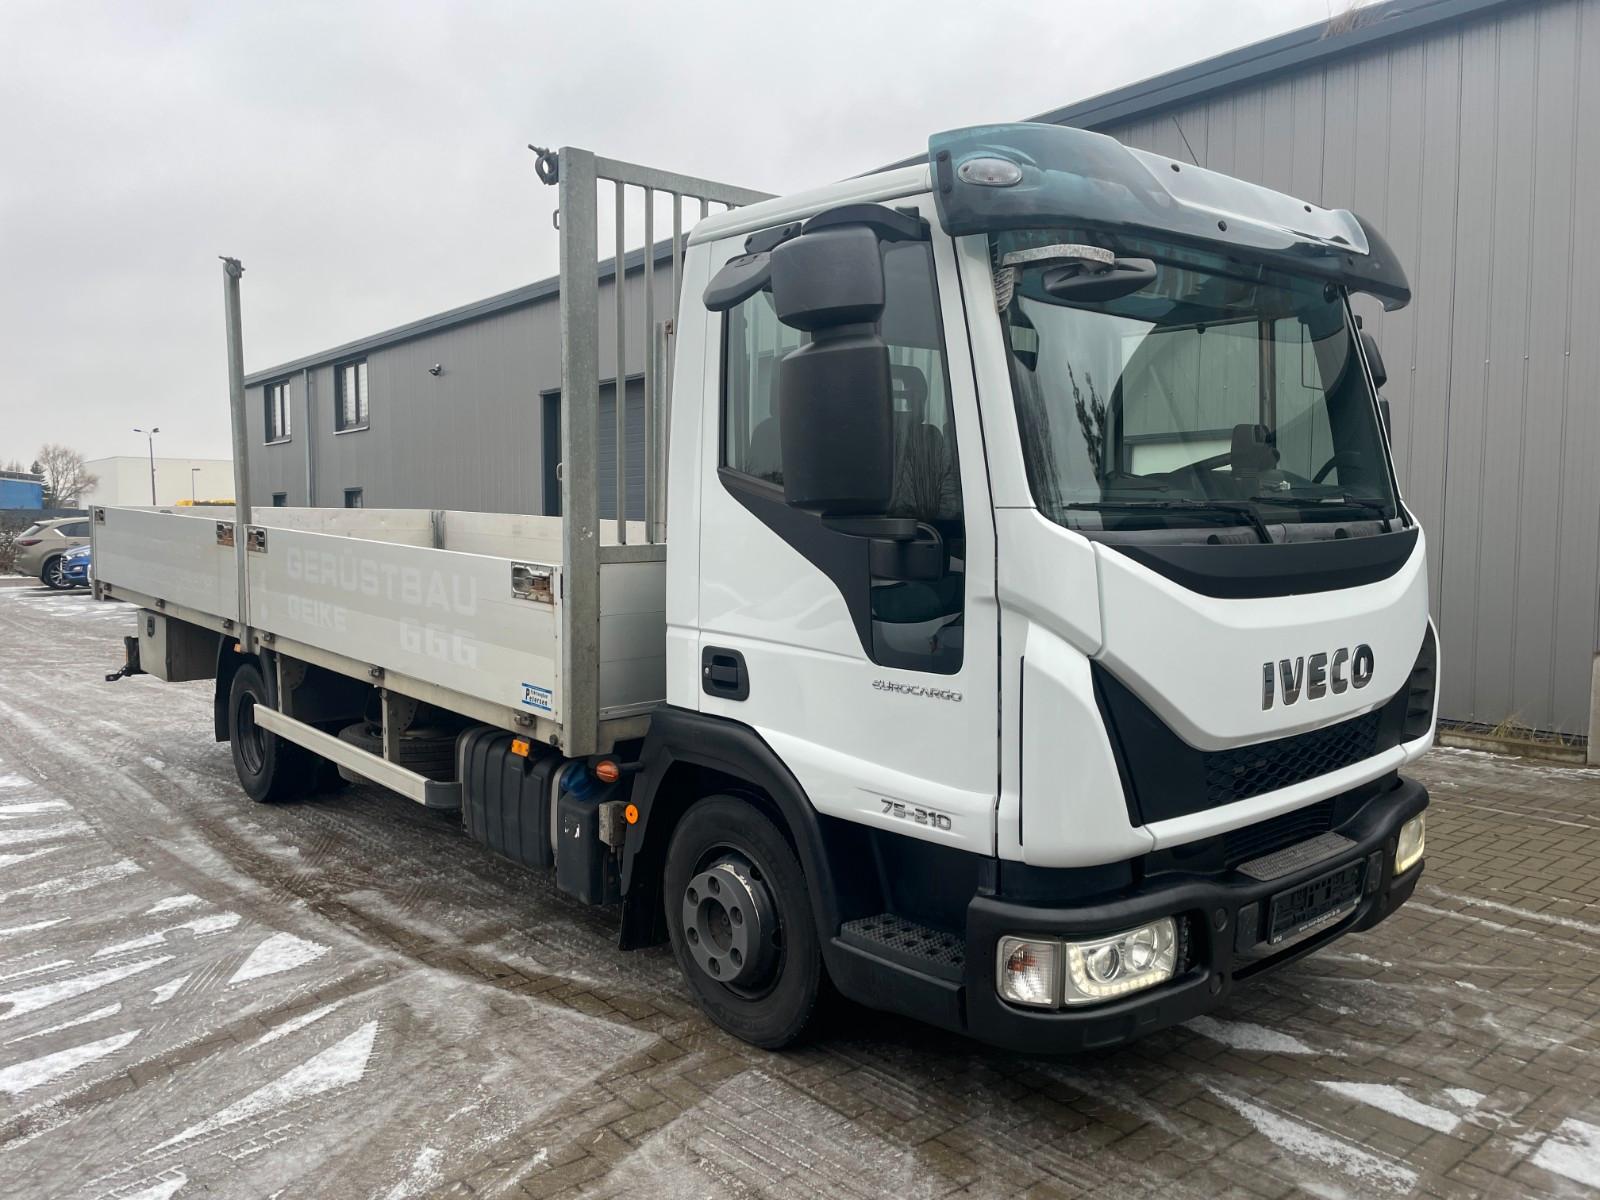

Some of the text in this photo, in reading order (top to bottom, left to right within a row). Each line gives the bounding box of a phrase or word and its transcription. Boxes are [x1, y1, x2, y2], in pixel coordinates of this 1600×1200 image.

[872, 679, 963, 702] EUROCARGO
[1261, 643, 1375, 711] IVECO
[881, 798, 952, 831] 75-210
